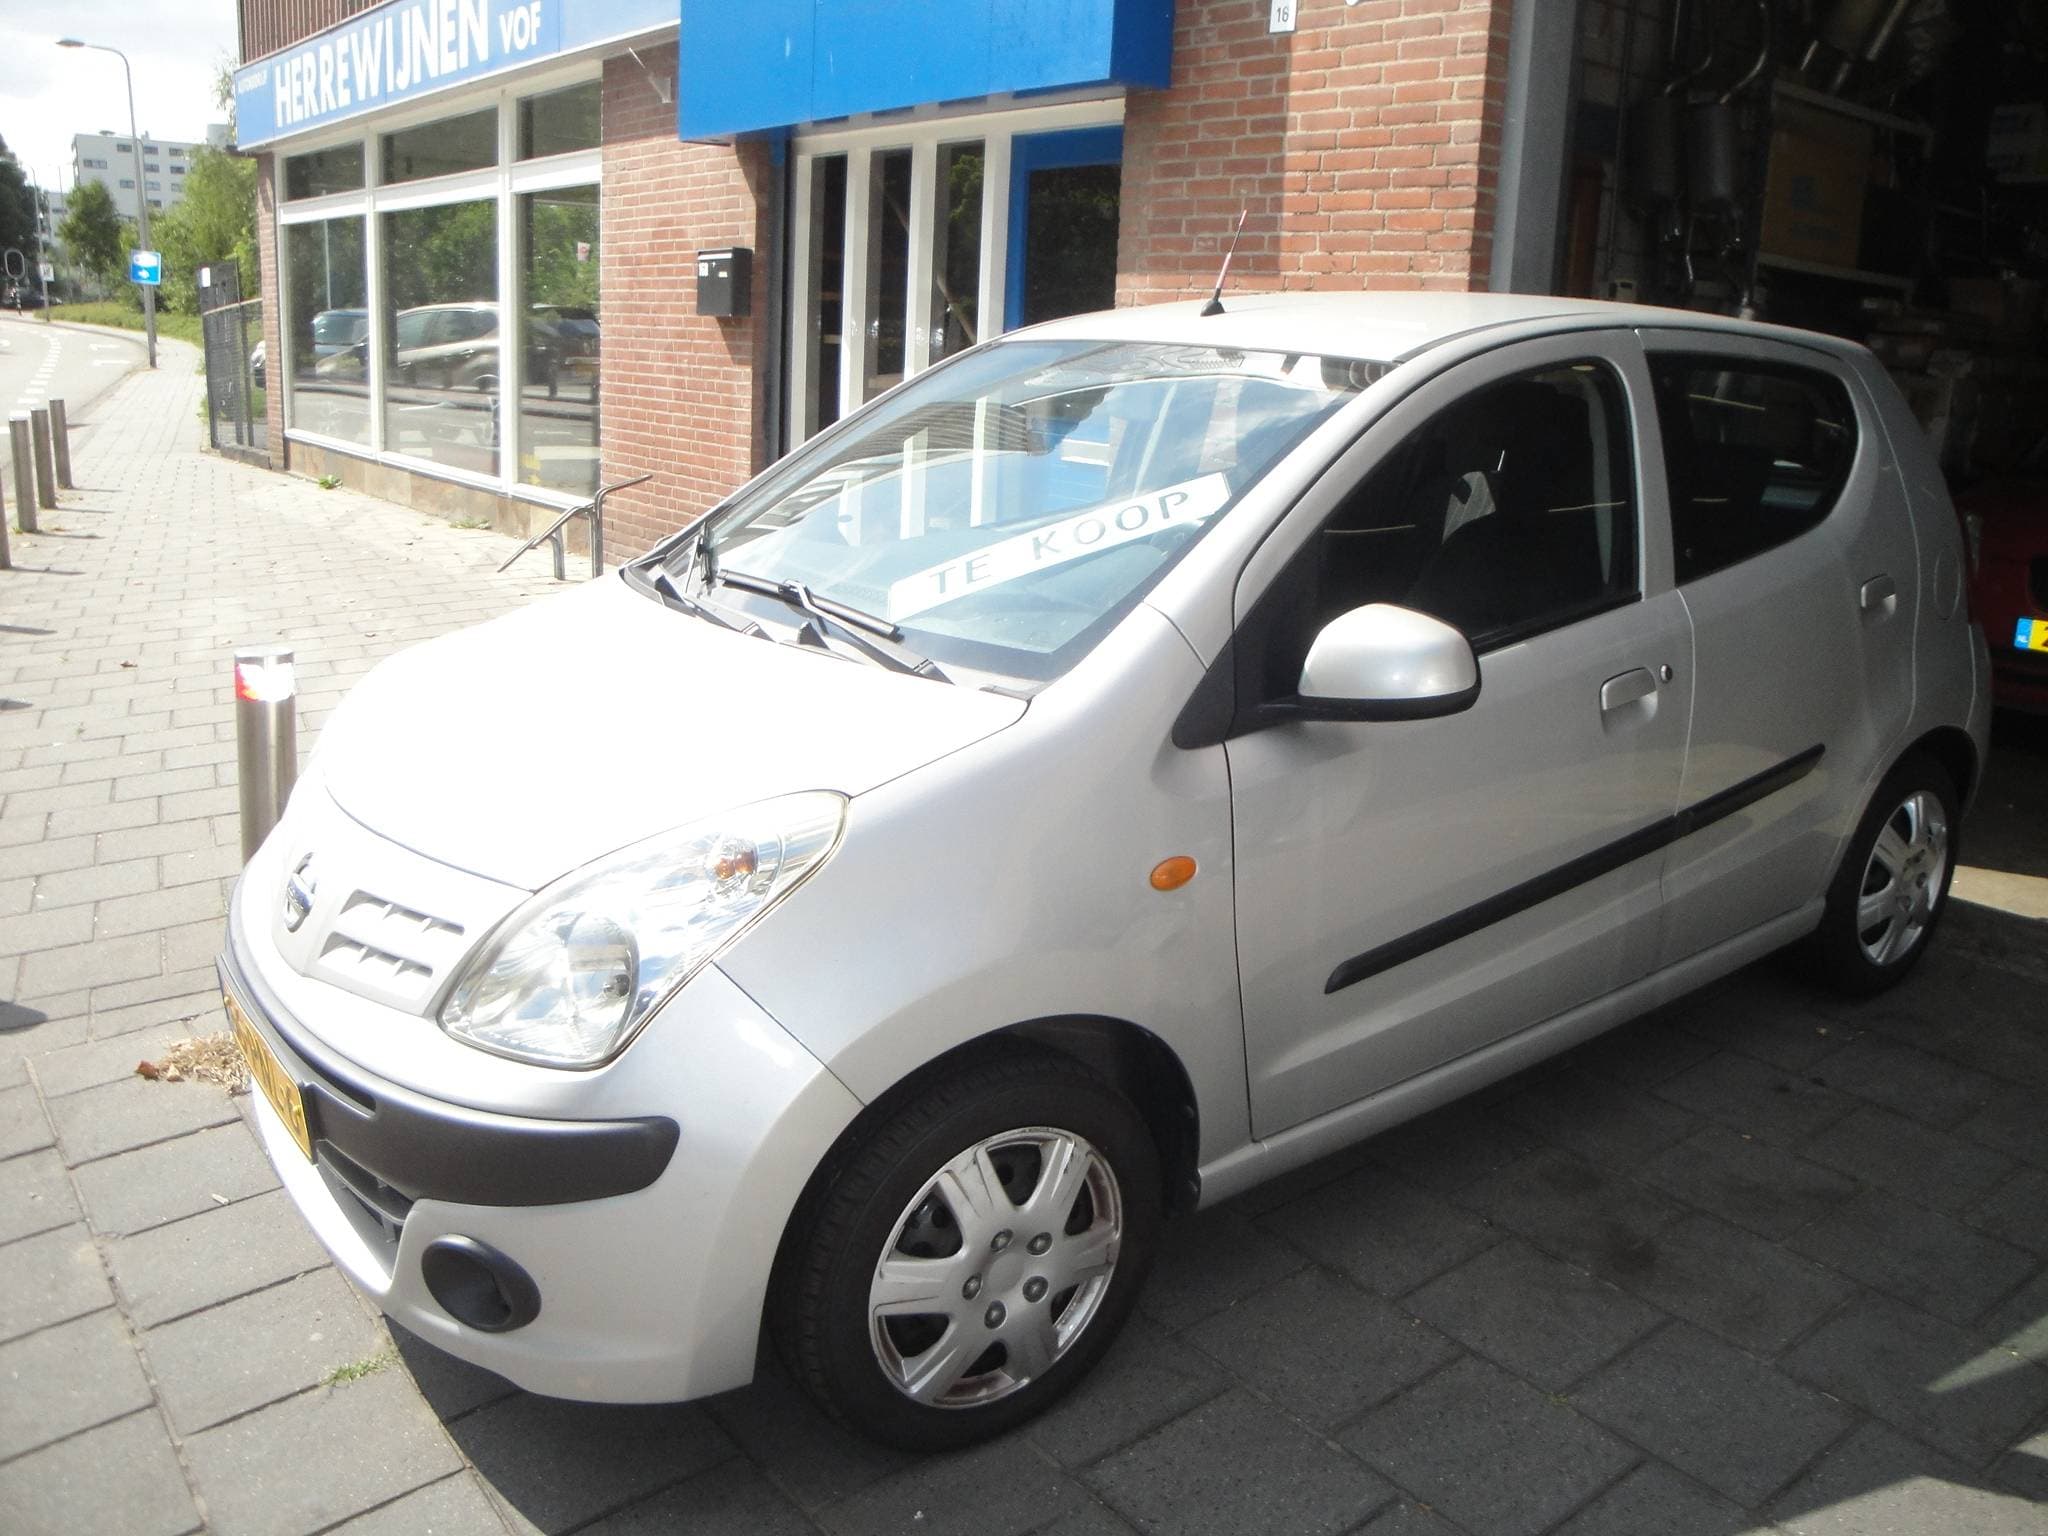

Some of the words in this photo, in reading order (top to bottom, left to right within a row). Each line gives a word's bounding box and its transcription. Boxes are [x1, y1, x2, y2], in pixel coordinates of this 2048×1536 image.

[275, 0, 489, 128] HERREWIJNEN
[499, 1, 541, 54] VOF
[1277, 6, 1289, 23] 16
[929, 553, 992, 595] TE
[1031, 491, 1189, 561] KOOP
